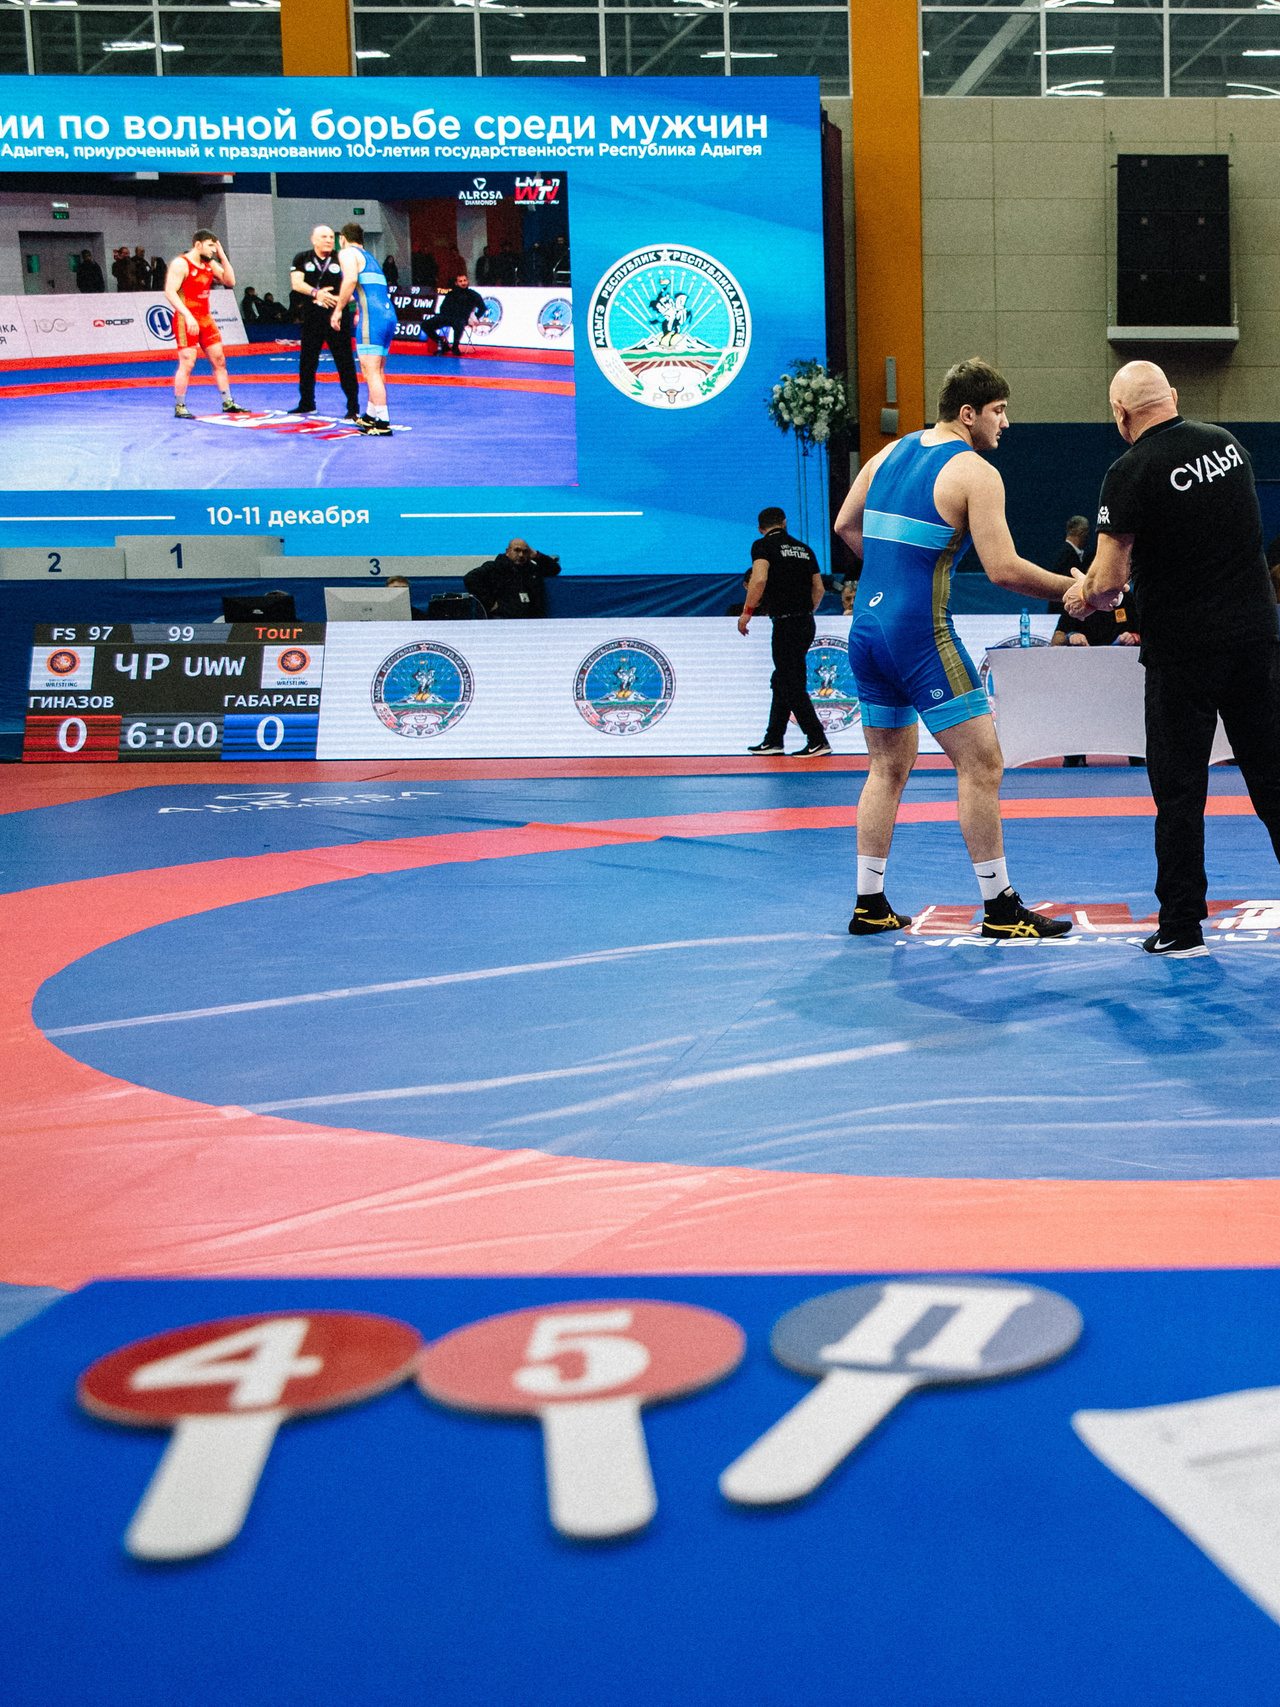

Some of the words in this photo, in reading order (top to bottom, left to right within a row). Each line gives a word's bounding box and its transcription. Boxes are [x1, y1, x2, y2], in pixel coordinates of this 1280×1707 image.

[59, 115, 110, 140] по
[124, 108, 297, 140] вольной
[311, 108, 461, 146] борьбе
[474, 115, 596, 145] среди
[611, 115, 768, 145] мужчин
[2, 143, 69, 159] Адыгея,
[73, 143, 200, 159] приуроченный
[205, 147, 215, 158] к
[219, 146, 342, 160] празднованию
[346, 143, 430, 158] 100-летия
[435, 145, 594, 160] государственности
[598, 143, 696, 158] Республика
[701, 143, 762, 157] Адыгея
[458, 191, 503, 200] ALROSA
[602, 252, 657, 299] РЕСПУБЛИК
[672, 251, 736, 299] РЕСПУБЛИКА
[732, 301, 746, 347] АДЫГЕЯ
[1170, 443, 1244, 491] СУДЬЯ
[206, 507, 262, 527] 10-11
[268, 505, 370, 527] декабря
[47, 552, 63, 574] 2
[169, 543, 184, 569] 1
[369, 557, 382, 576] 3
[53, 628, 76, 641] FS
[88, 626, 114, 641] 97
[168, 626, 195, 642] 99
[254, 627, 303, 640] Tour
[114, 653, 170, 680] ЧР
[184, 656, 246, 677] UWW
[29, 695, 115, 709] ГИНАЗОВ
[223, 694, 320, 708] ГАБАРАЕВ
[58, 717, 88, 753] 0
[126, 721, 218, 749] 6:00
[256, 715, 285, 751] 0
[820, 1283, 1033, 1370] П
[128, 1318, 325, 1410] 4
[512, 1309, 651, 1397] 5
